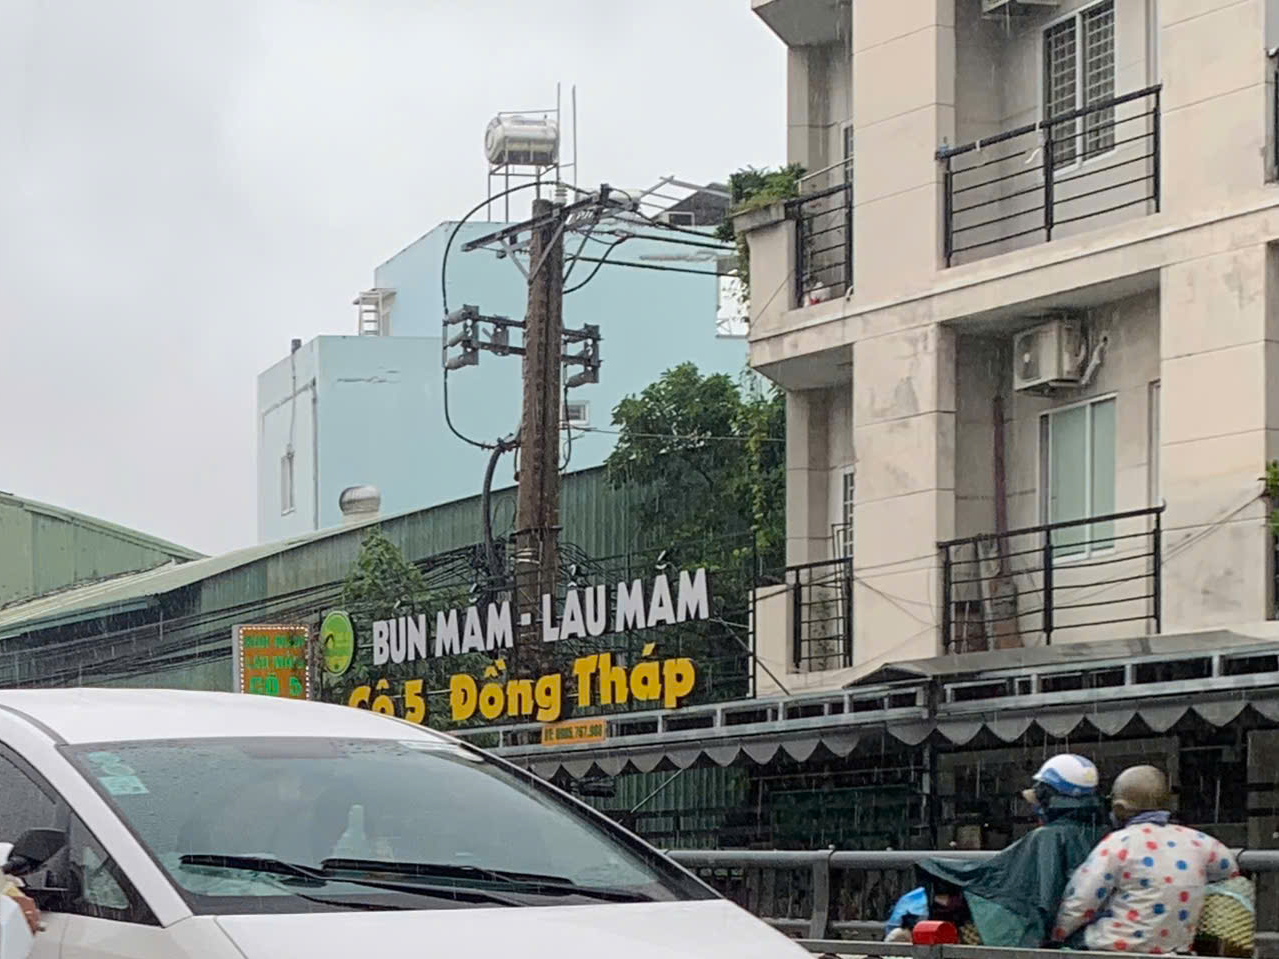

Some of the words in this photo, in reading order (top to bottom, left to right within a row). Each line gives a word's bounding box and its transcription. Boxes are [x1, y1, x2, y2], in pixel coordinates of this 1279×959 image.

[404, 679, 426, 725] 5
[449, 658, 562, 723] Đồng
[573, 642, 697, 709] Tháp
